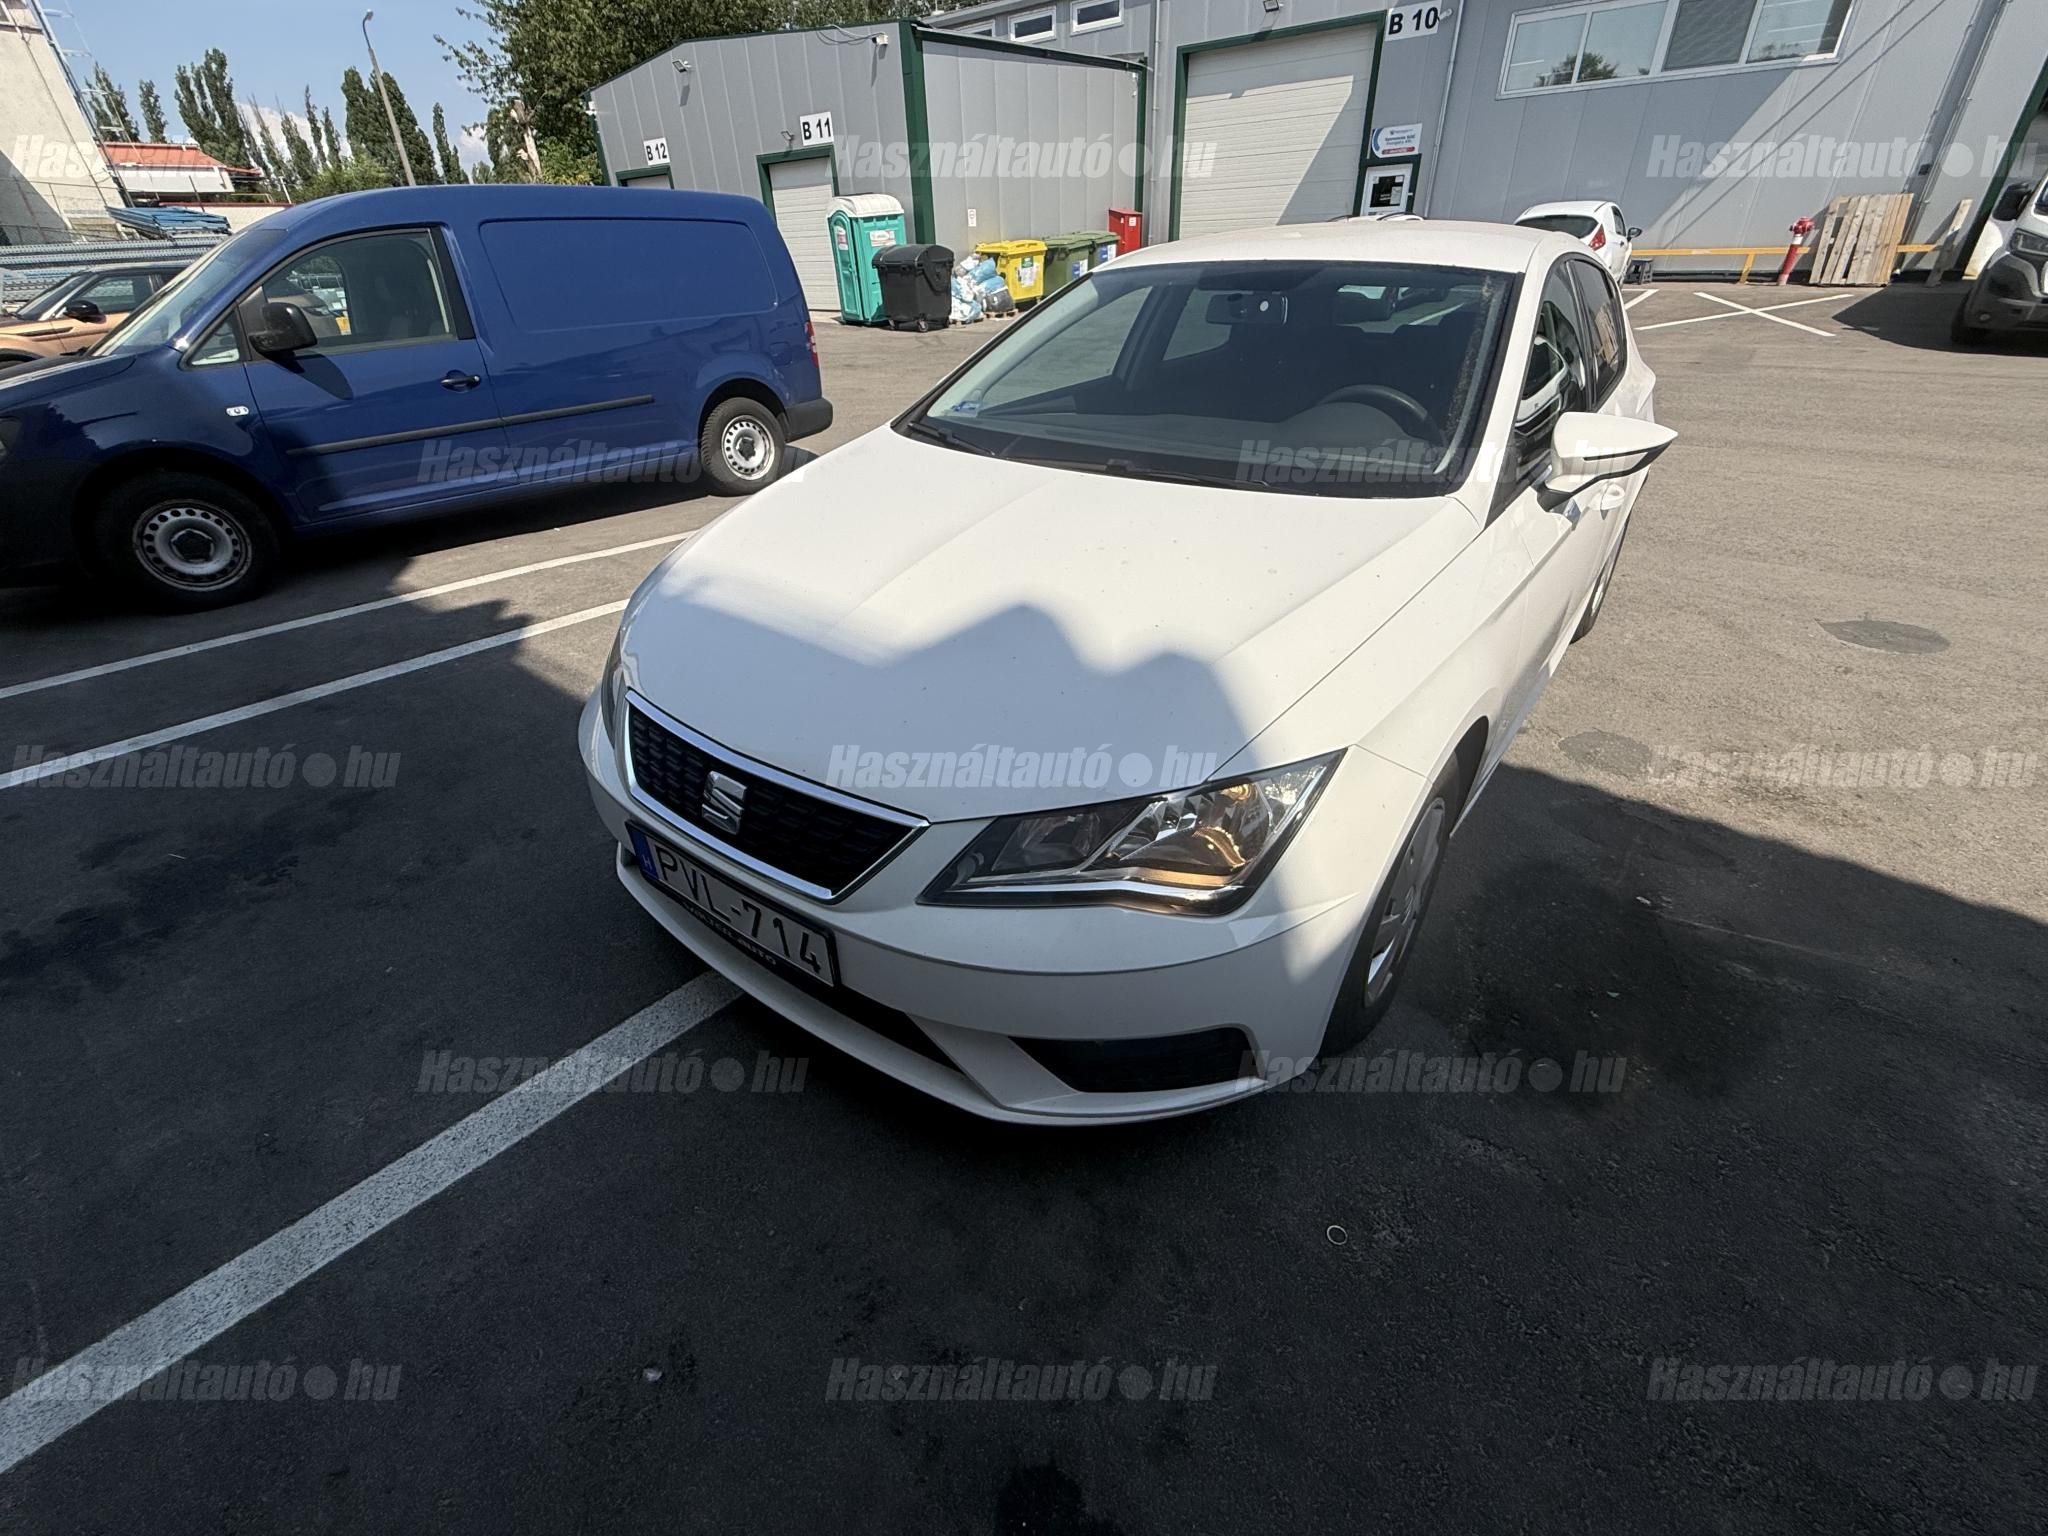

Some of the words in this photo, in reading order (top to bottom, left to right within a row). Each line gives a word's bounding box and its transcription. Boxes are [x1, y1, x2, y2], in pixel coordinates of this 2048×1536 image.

[1388, 13, 1404, 35] B
[1412, 6, 1439, 31] 10
[802, 121, 812, 140] B
[816, 117, 831, 139] 11
[645, 145, 654, 161] B
[655, 142, 668, 160] 12
[654, 845, 822, 974] PVL-714
